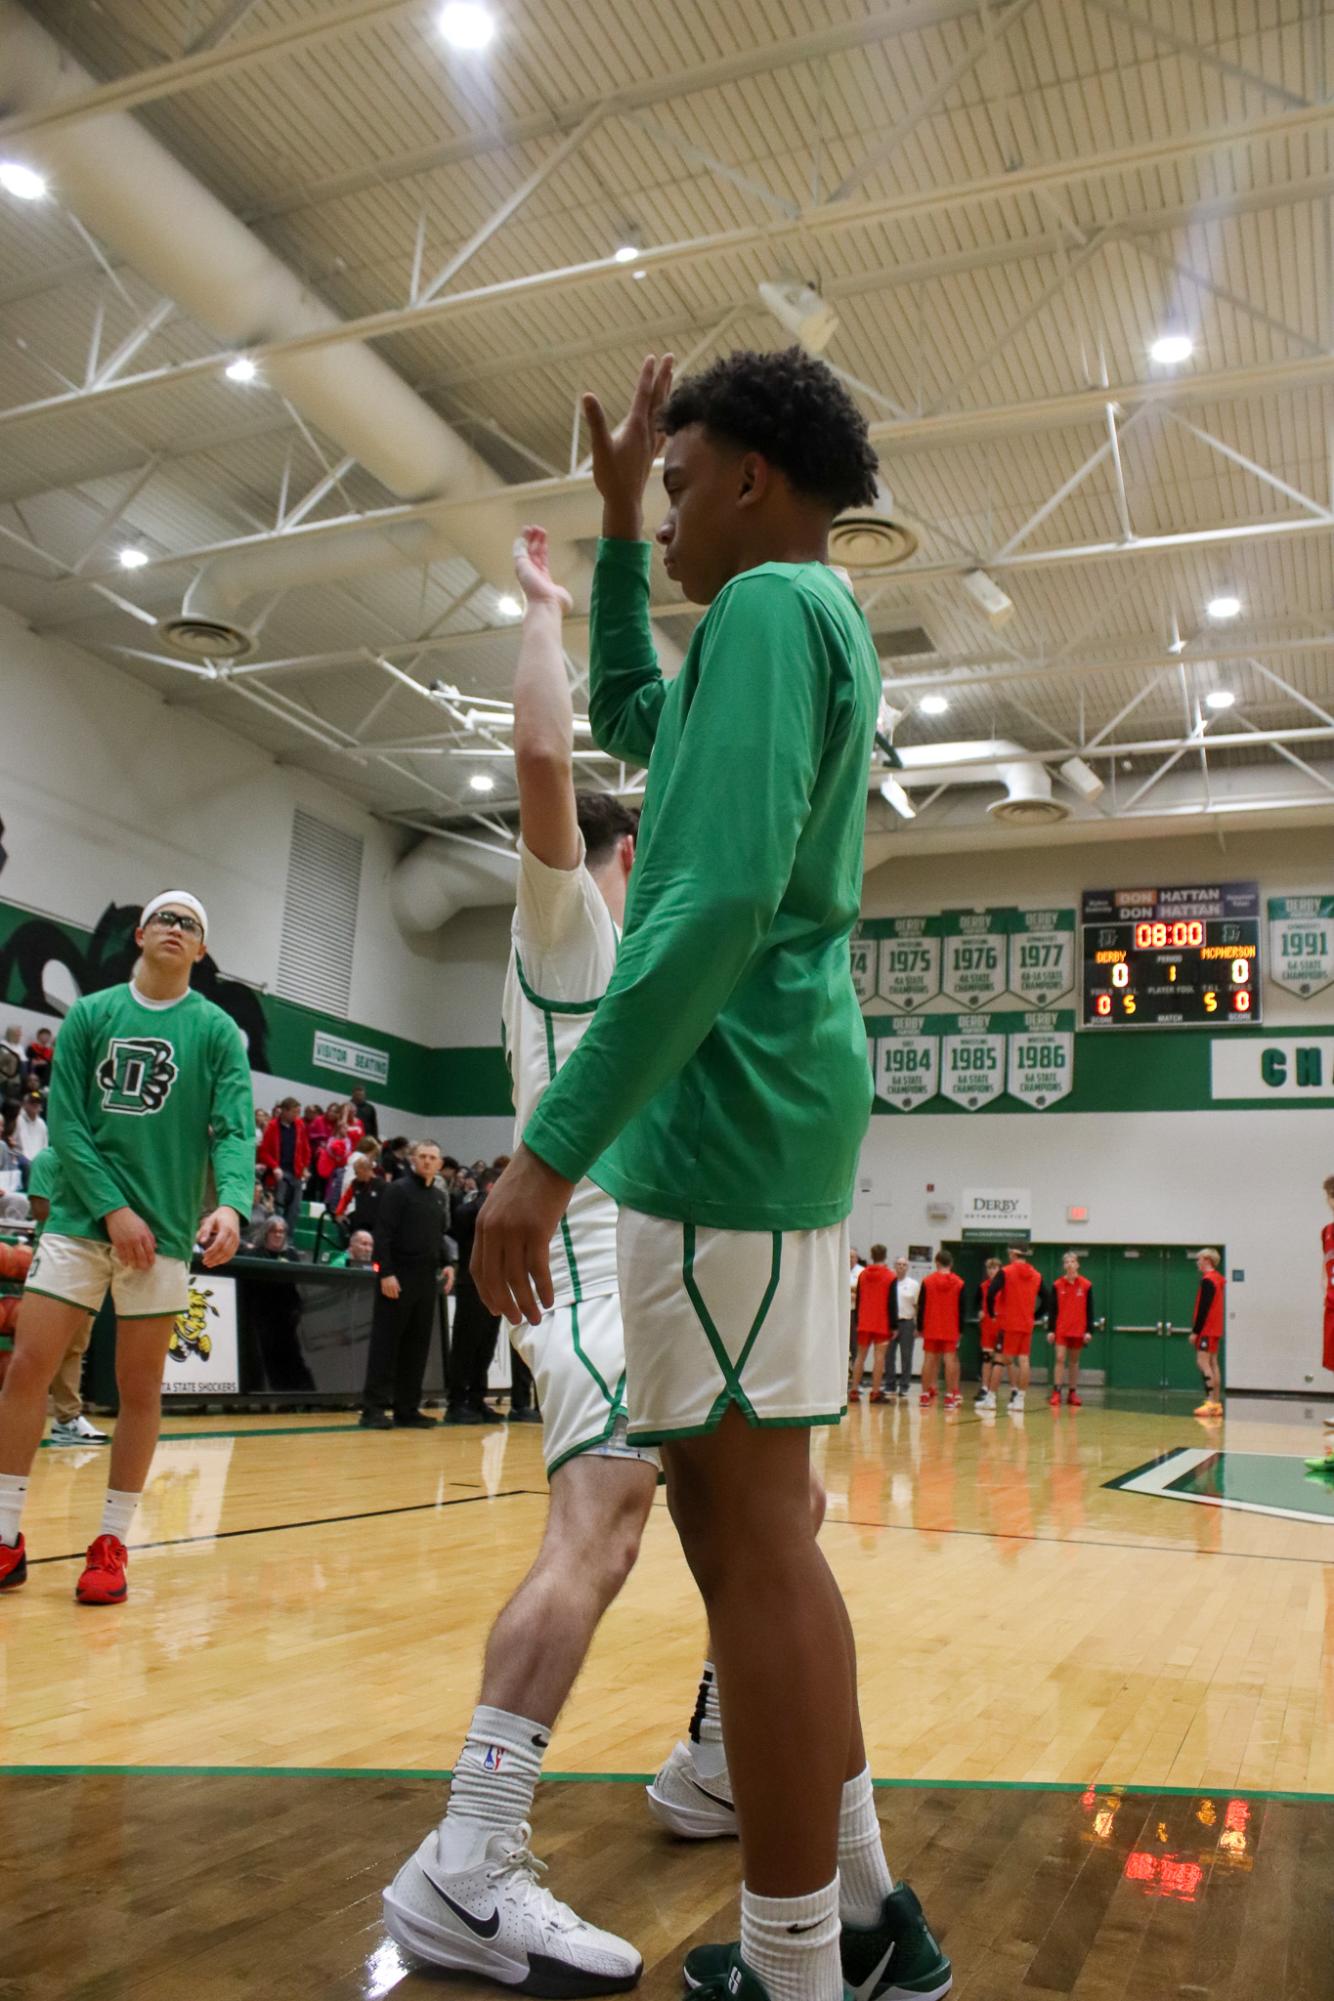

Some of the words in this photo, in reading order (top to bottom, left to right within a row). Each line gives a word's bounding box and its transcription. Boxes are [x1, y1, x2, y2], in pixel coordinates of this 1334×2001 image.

[1160, 889, 1220, 903] HATTAN
[1119, 907, 1153, 919] DON
[1161, 904, 1221, 917] HATTAN
[1136, 921, 1203, 948] 08:00
[1281, 931, 1328, 957] 1991
[889, 950, 931, 973] 1975
[953, 947, 998, 971] 1976
[1020, 944, 1064, 968] 1977
[1095, 951, 1127, 964] DERBY
[1112, 963, 1129, 987] 0
[1169, 965, 1177, 982] 1
[1231, 959, 1249, 984] 0
[1097, 994, 1112, 1015] 0
[1234, 990, 1250, 1011] 0
[884, 1048, 932, 1073] 1984
[951, 1048, 997, 1071] 1985
[1017, 1045, 1066, 1069] 1986
[973, 1198, 1019, 1213] DERBY
[173, 1382, 196, 1392] STATE
[198, 1382, 236, 1392] SHOCKERS
